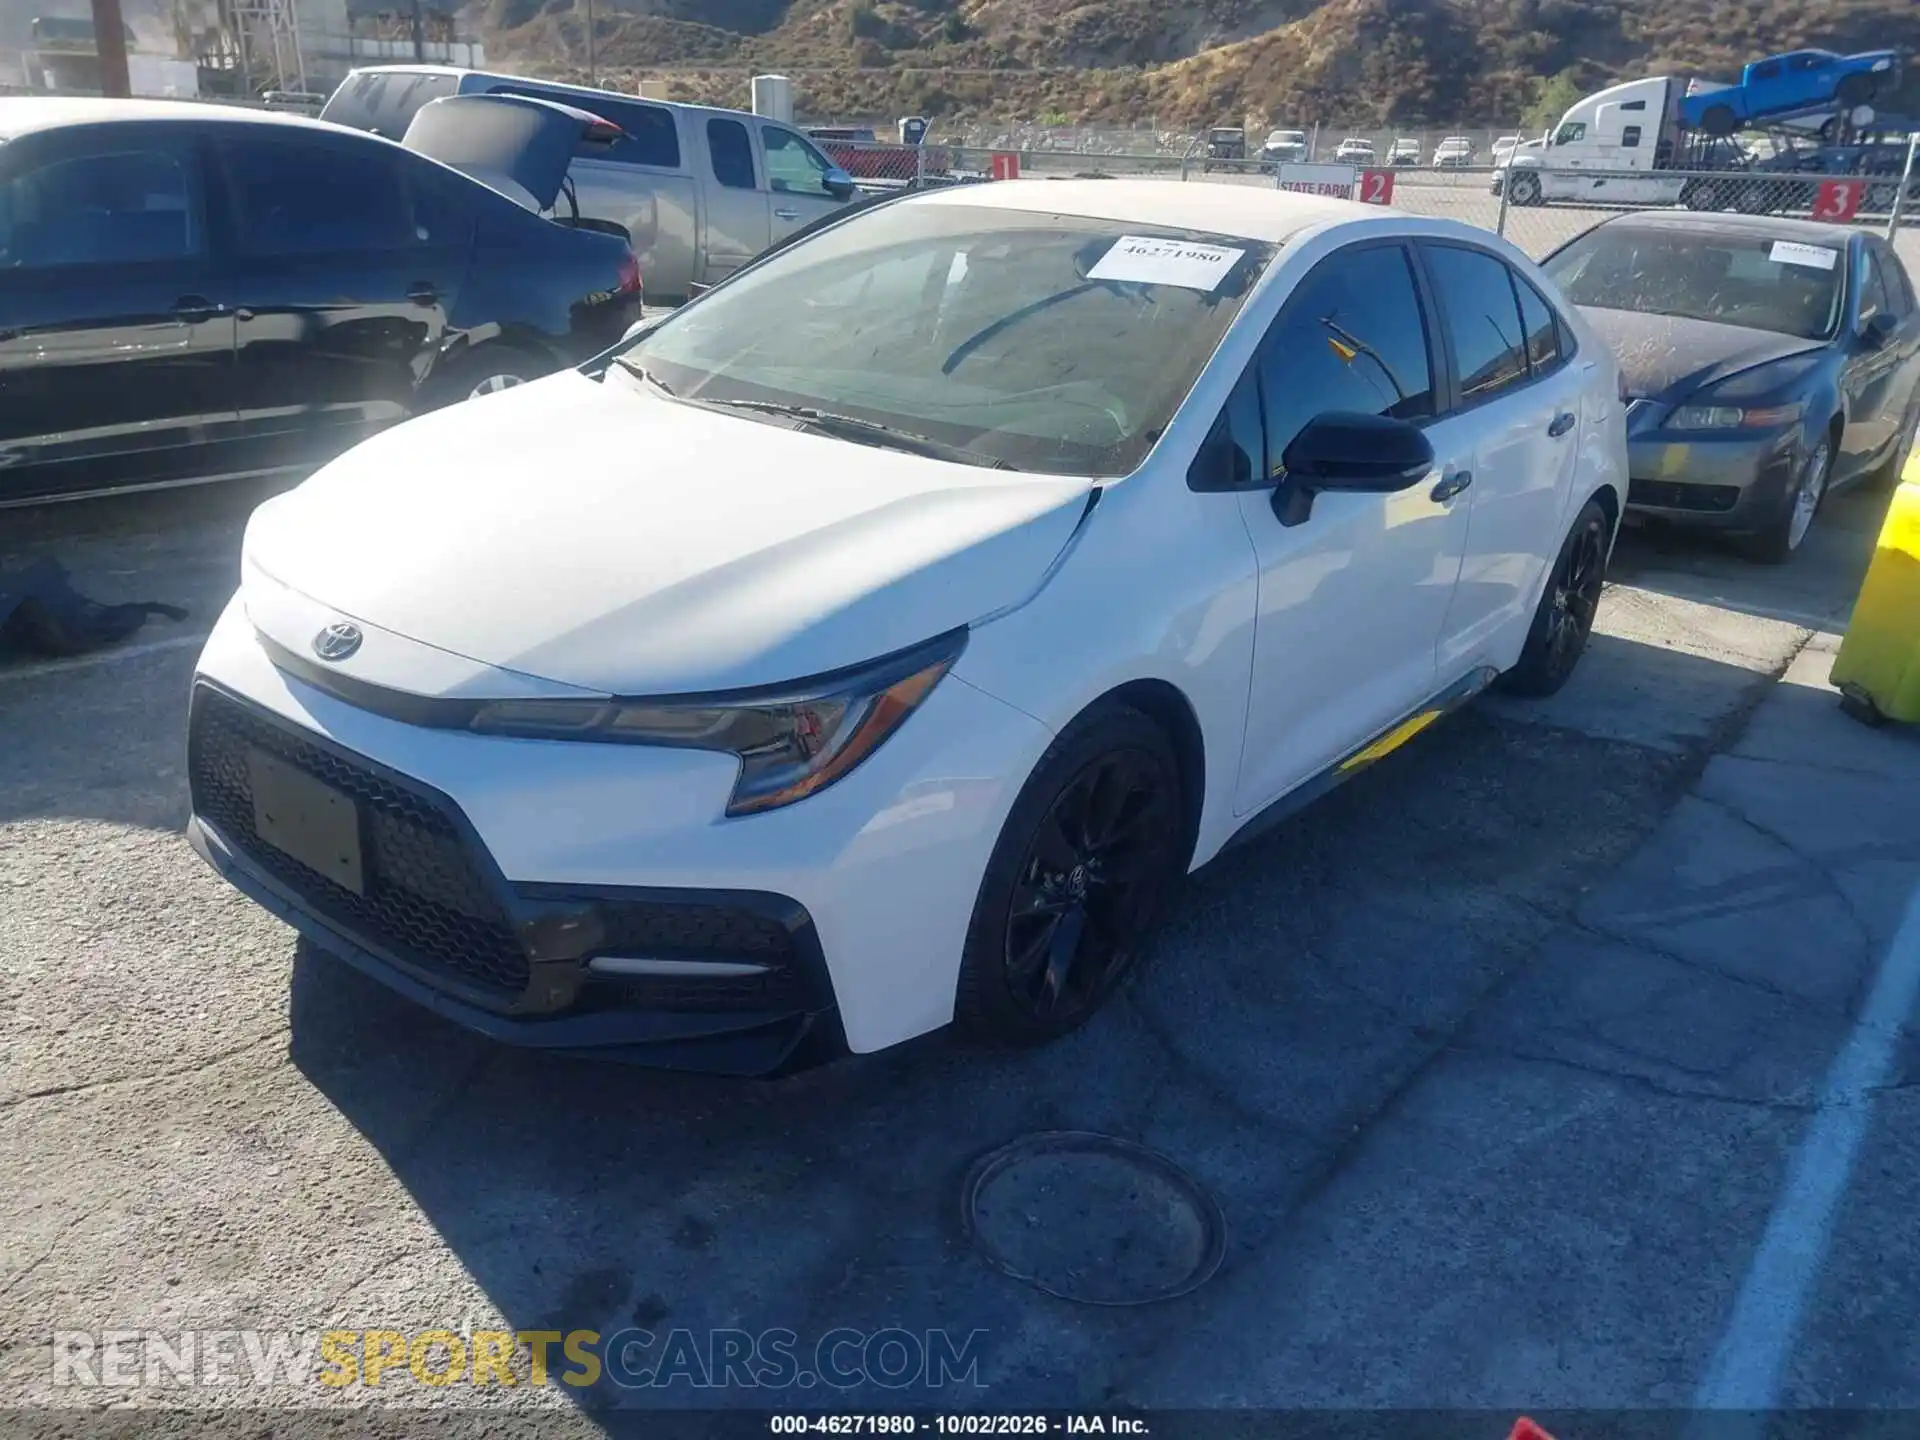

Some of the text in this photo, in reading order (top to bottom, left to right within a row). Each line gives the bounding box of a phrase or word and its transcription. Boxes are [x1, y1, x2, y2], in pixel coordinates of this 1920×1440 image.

[1001, 157, 1009, 179] 1
[1280, 181, 1351, 199] STATE FARM
[1367, 175, 1386, 202] 2
[1824, 185, 1849, 216] 3
[1124, 246, 1222, 263] 46271980
